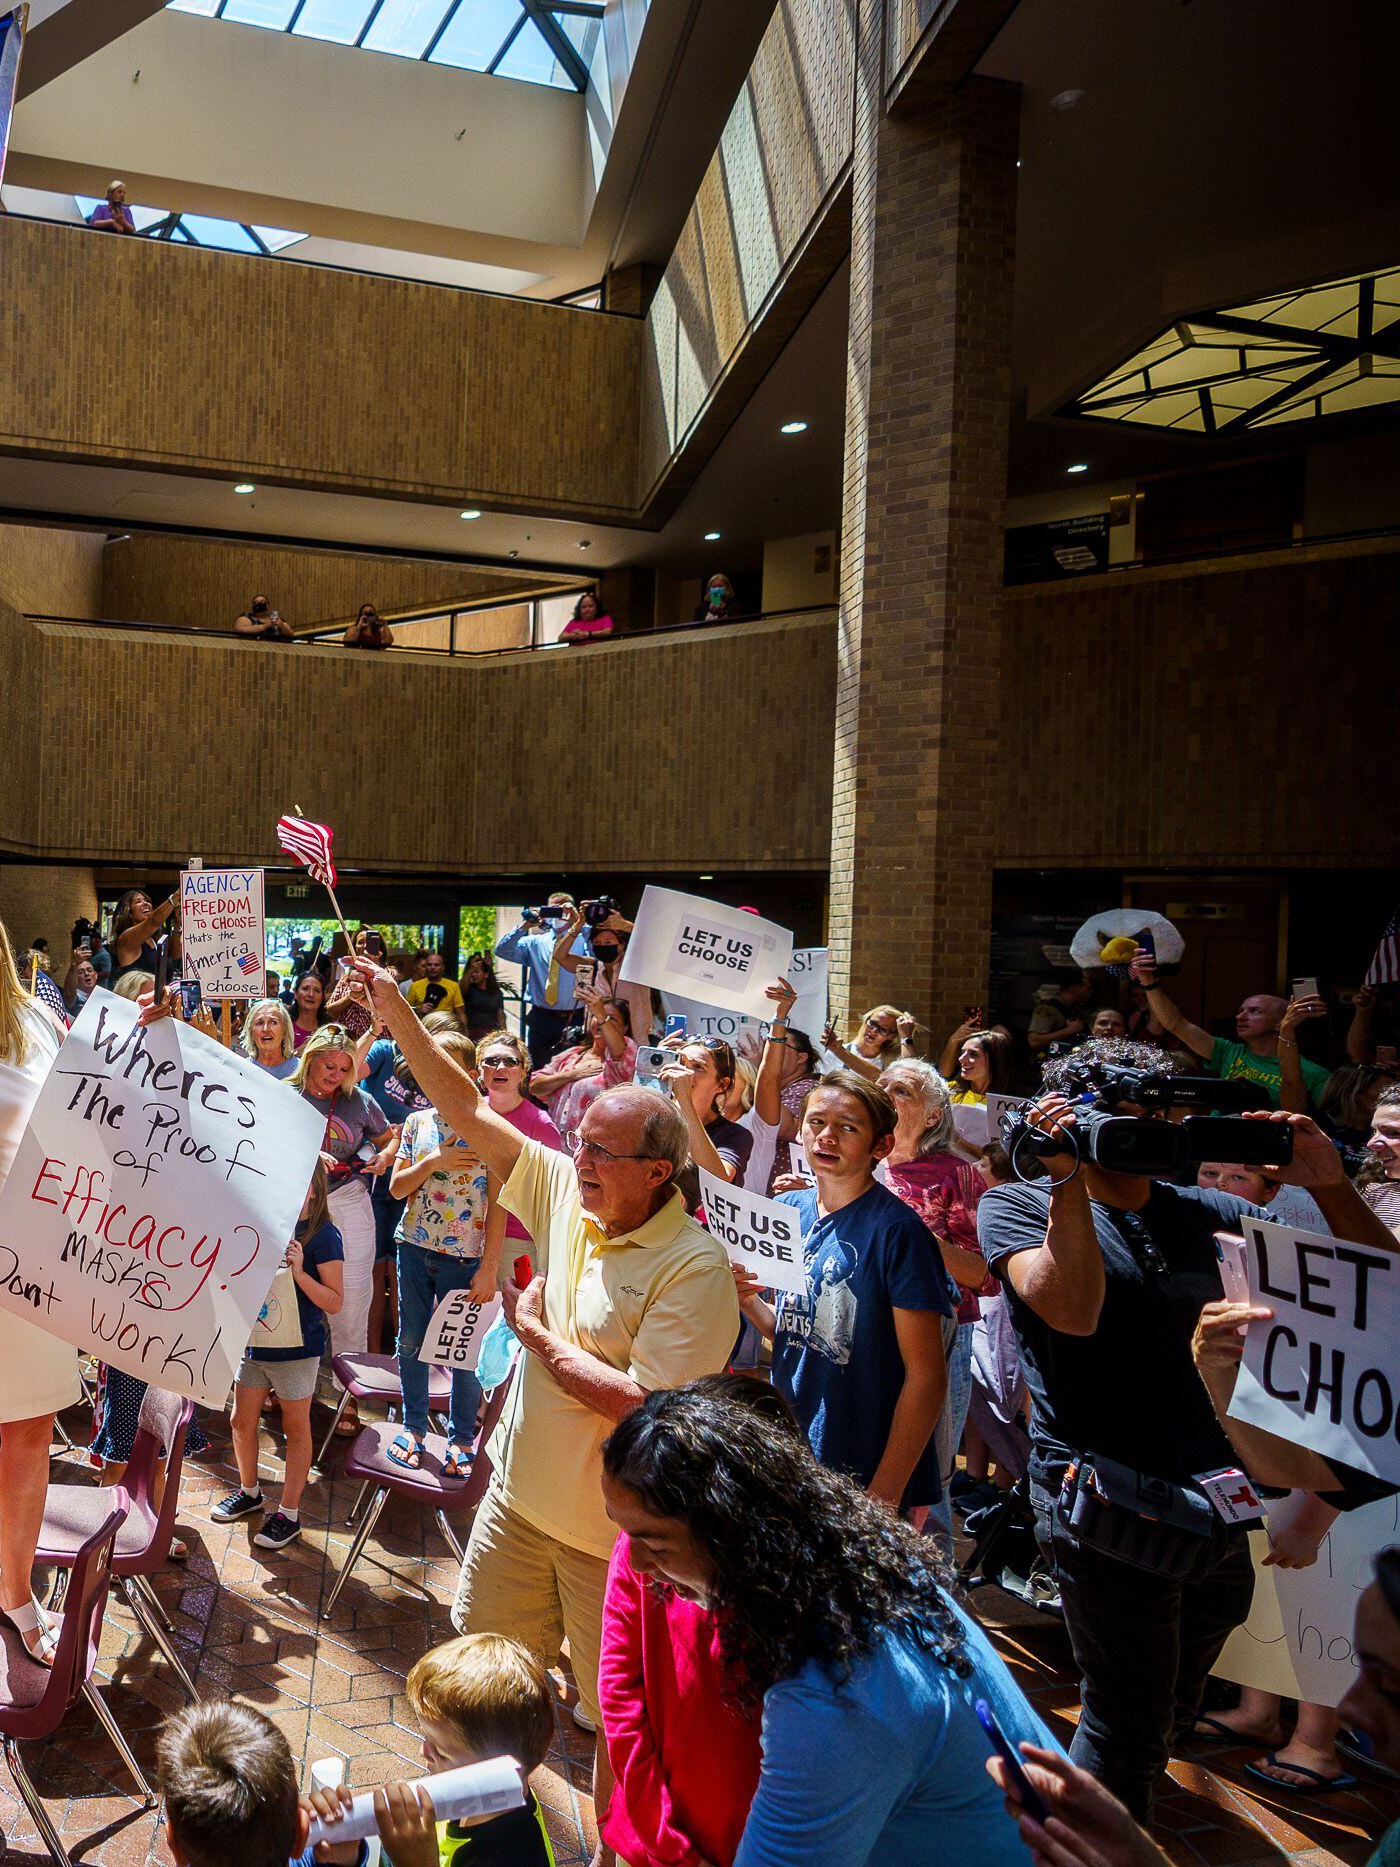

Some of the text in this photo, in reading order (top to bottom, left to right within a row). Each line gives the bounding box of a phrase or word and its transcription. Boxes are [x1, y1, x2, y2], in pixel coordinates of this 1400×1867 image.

[184, 873, 255, 896] AGENCY
[285, 885, 310, 898] EXIT
[182, 895, 252, 916] FREEDOM
[211, 916, 257, 930] CHOOSE
[184, 930, 237, 945] that's the
[682, 926, 753, 958] LET US
[183, 942, 249, 980] America
[223, 965, 233, 980] I
[678, 941, 750, 973] CHOOSE
[206, 979, 265, 996] choose!
[1143, 1088, 1160, 1097] JVC
[55, 1069, 267, 1182] The Proof
[112, 1149, 164, 1189] of
[704, 1187, 792, 1242] LET US
[31, 1156, 262, 1313] Efficacy?
[708, 1211, 794, 1264] CHOOSE
[1251, 1228, 1391, 1332] LET
[434, 1293, 468, 1361] LET US
[453, 1302, 482, 1362] CHOOS
[90, 1297, 223, 1401] Work!
[1261, 1324, 1400, 1447] CHO
[1213, 1483, 1240, 1520] TELEMUNDO
